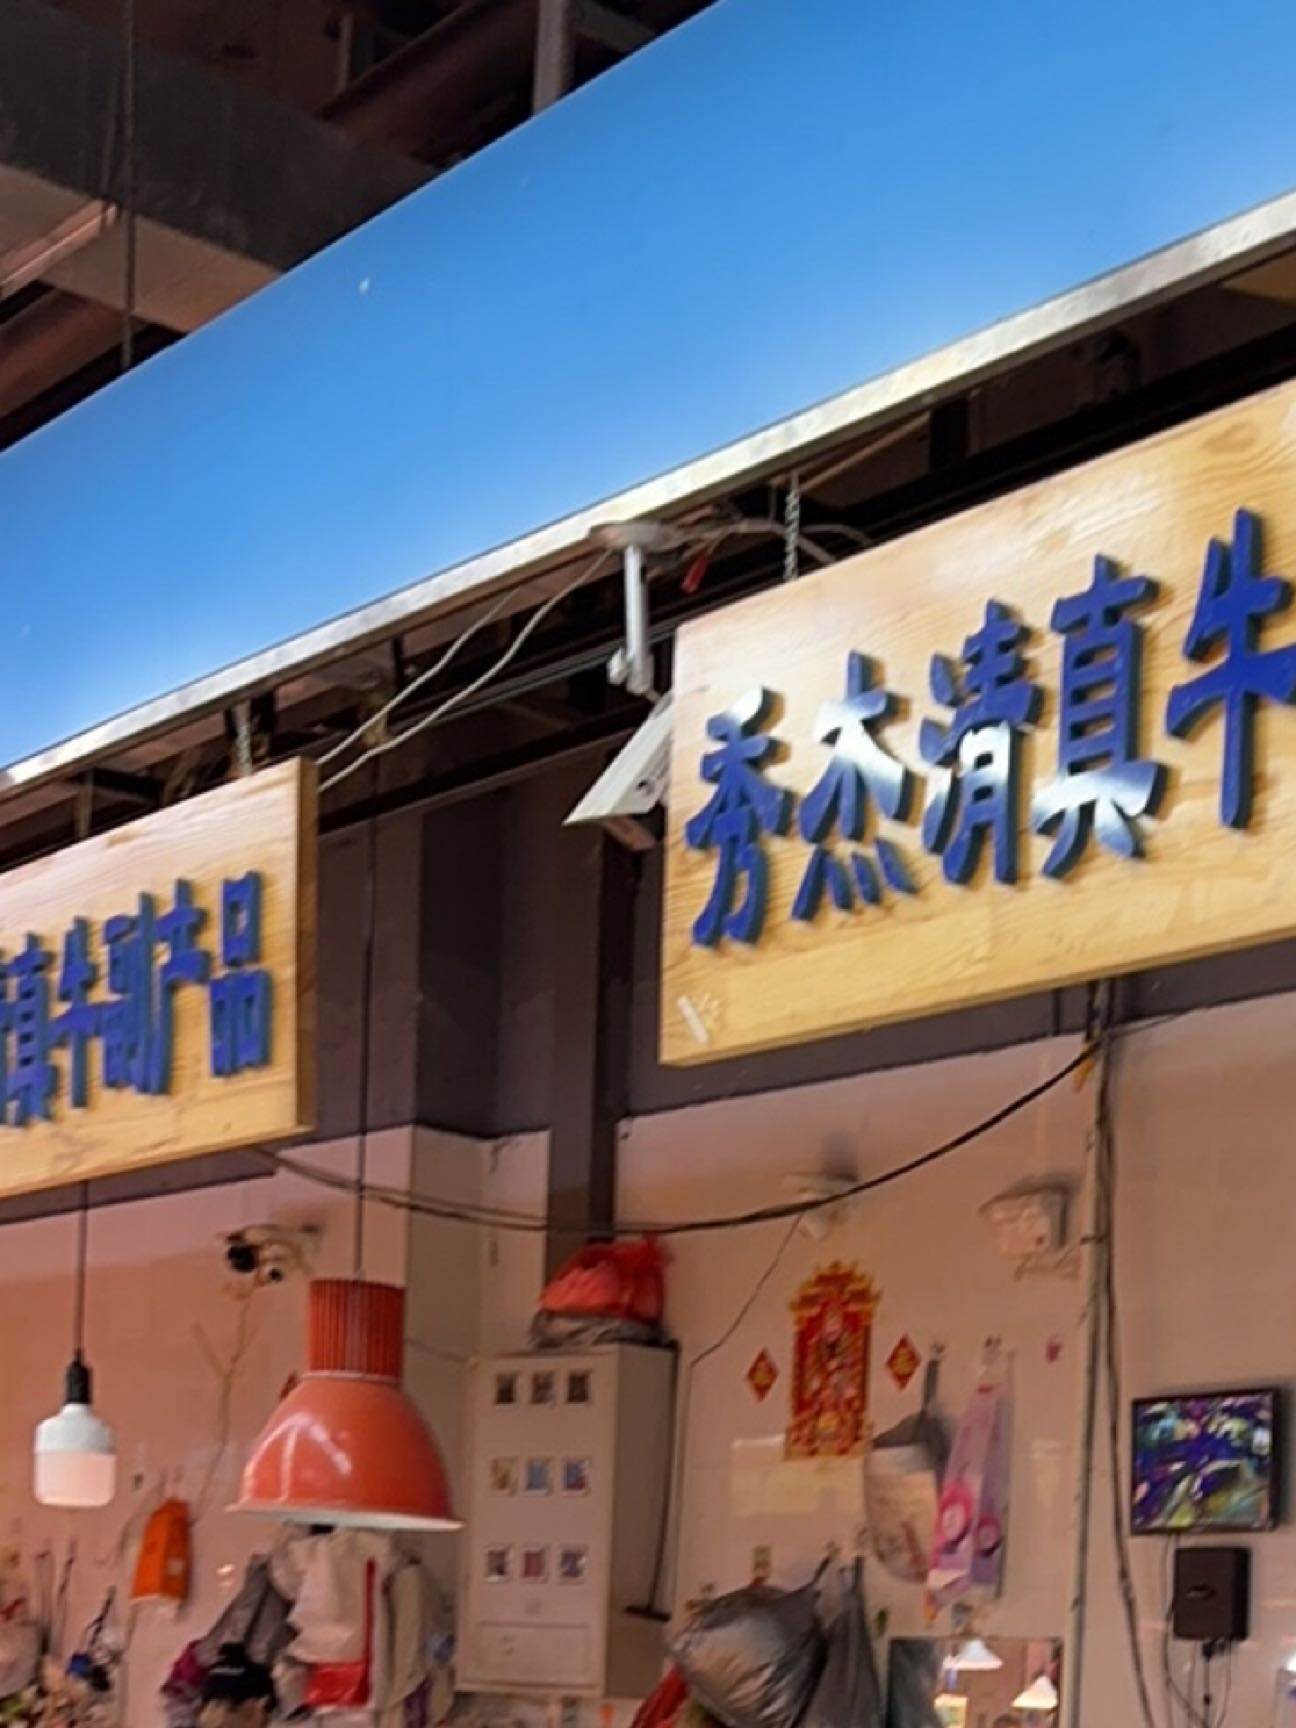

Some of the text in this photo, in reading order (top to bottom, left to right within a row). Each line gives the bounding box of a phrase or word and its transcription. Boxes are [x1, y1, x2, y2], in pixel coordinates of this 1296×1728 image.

[0, 870, 273, 1127] 真牛副产品
